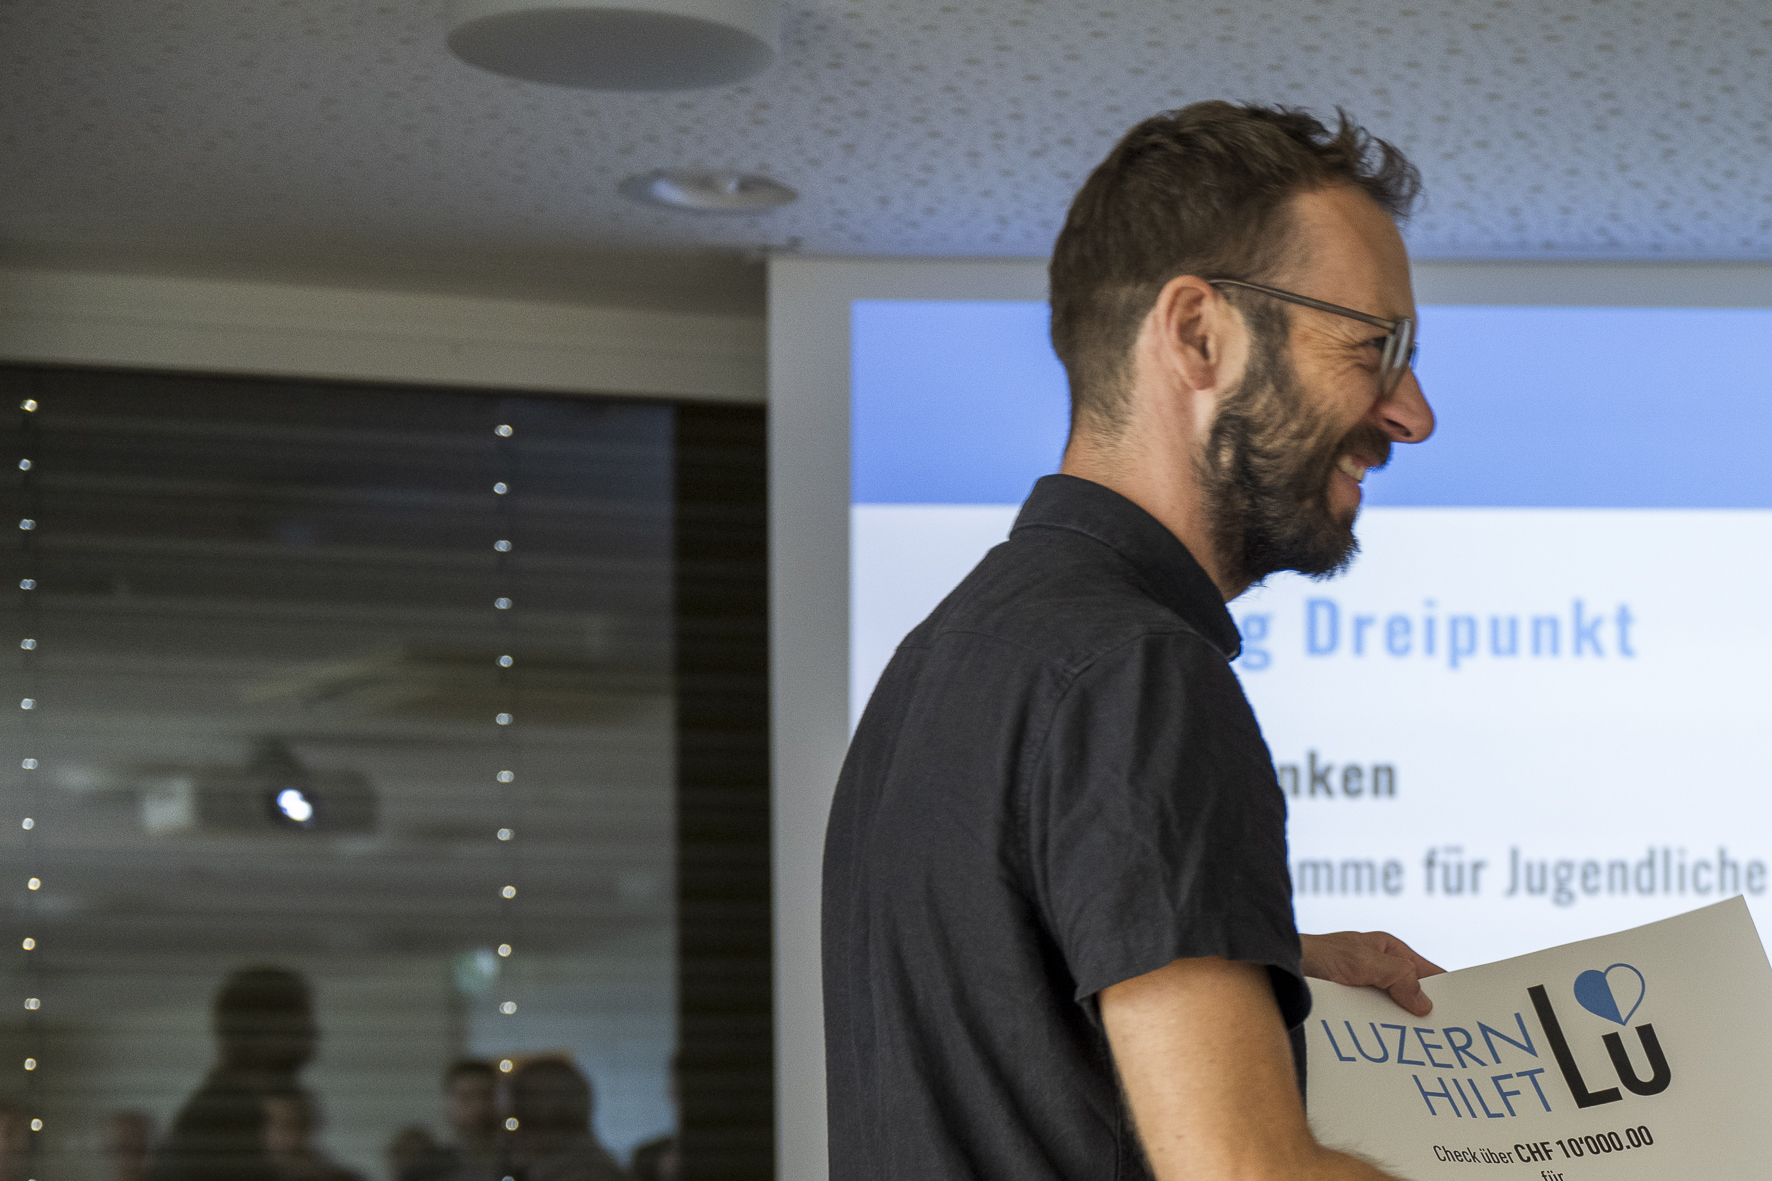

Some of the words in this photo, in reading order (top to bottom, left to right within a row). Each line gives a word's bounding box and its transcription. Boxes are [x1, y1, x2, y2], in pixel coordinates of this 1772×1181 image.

[1304, 596, 1636, 673] Dreipunkt
[1277, 748, 1397, 798] nken
[1296, 857, 1403, 897] mme
[1424, 845, 1488, 897] für
[1505, 846, 1768, 907] Jugendliche
[1321, 1012, 1539, 1069] LUZERN
[1412, 1067, 1552, 1119] HILFT
[1432, 1144, 1481, 1164] Check
[1481, 1147, 1516, 1165] über
[1513, 1141, 1554, 1163] CHF
[1555, 1125, 1655, 1159] 10'000.00
